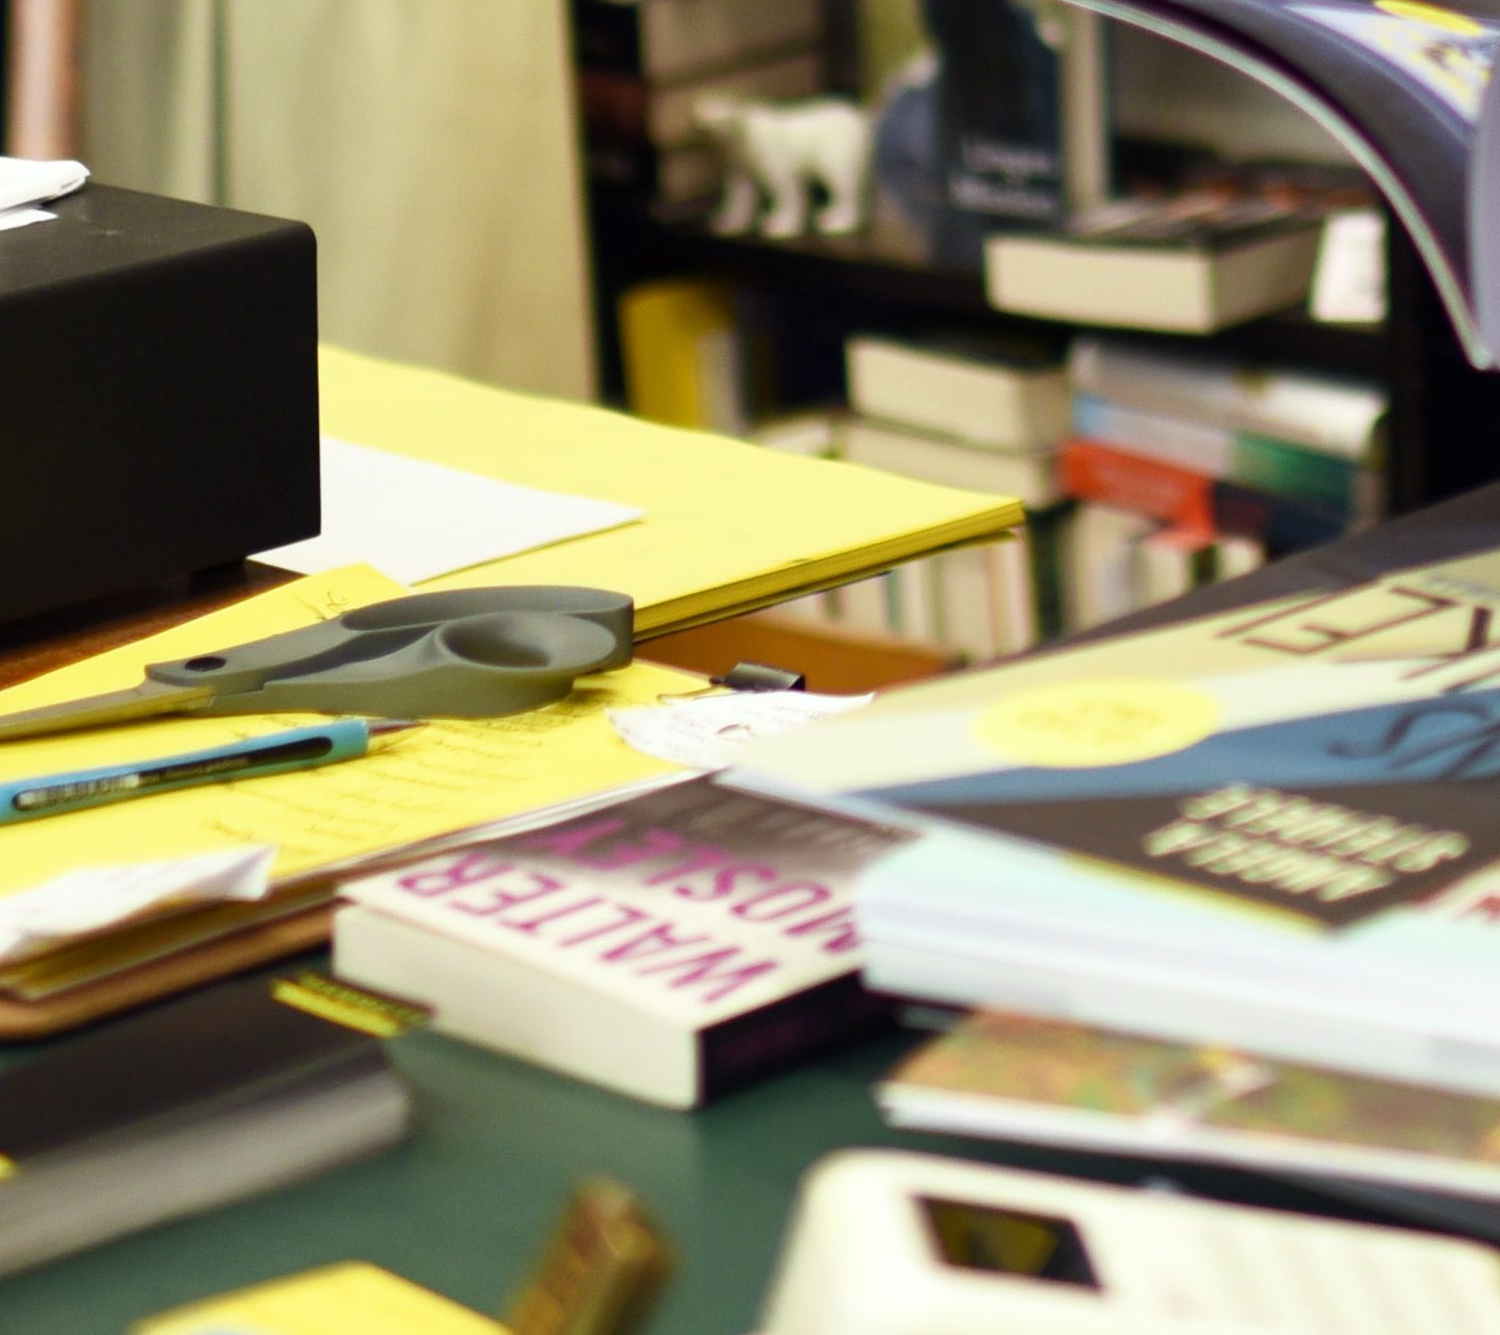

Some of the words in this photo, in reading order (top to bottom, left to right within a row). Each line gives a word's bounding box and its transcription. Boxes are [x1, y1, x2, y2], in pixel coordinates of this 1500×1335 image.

[396, 850, 779, 1006] WALTER
[526, 817, 862, 955] MOSLEY
[1141, 822, 1397, 905] ANGELA
